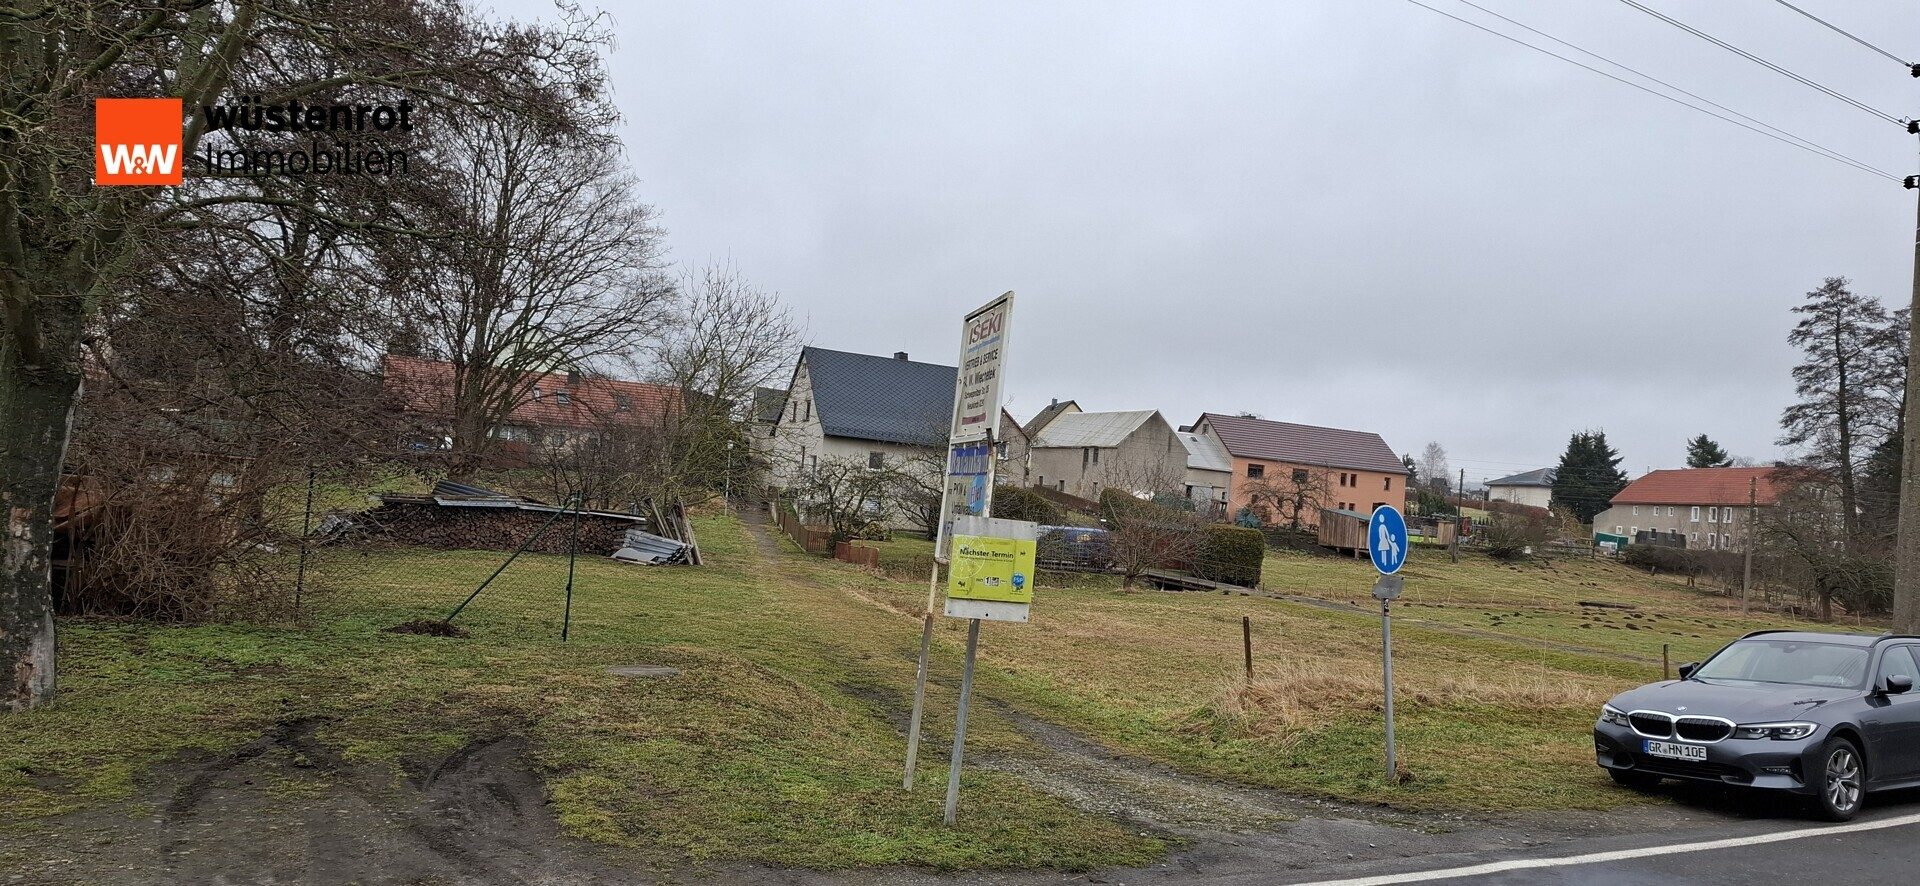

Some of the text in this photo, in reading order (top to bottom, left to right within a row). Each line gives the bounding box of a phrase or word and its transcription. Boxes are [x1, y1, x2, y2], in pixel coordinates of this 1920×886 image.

[969, 312, 1003, 345] ISEKI
[960, 547, 990, 557] Nächster
[991, 550, 1014, 559] Termin
[1649, 741, 1662, 753] GR
[1668, 744, 1682, 756] HN
[1685, 746, 1706, 759] 10E
